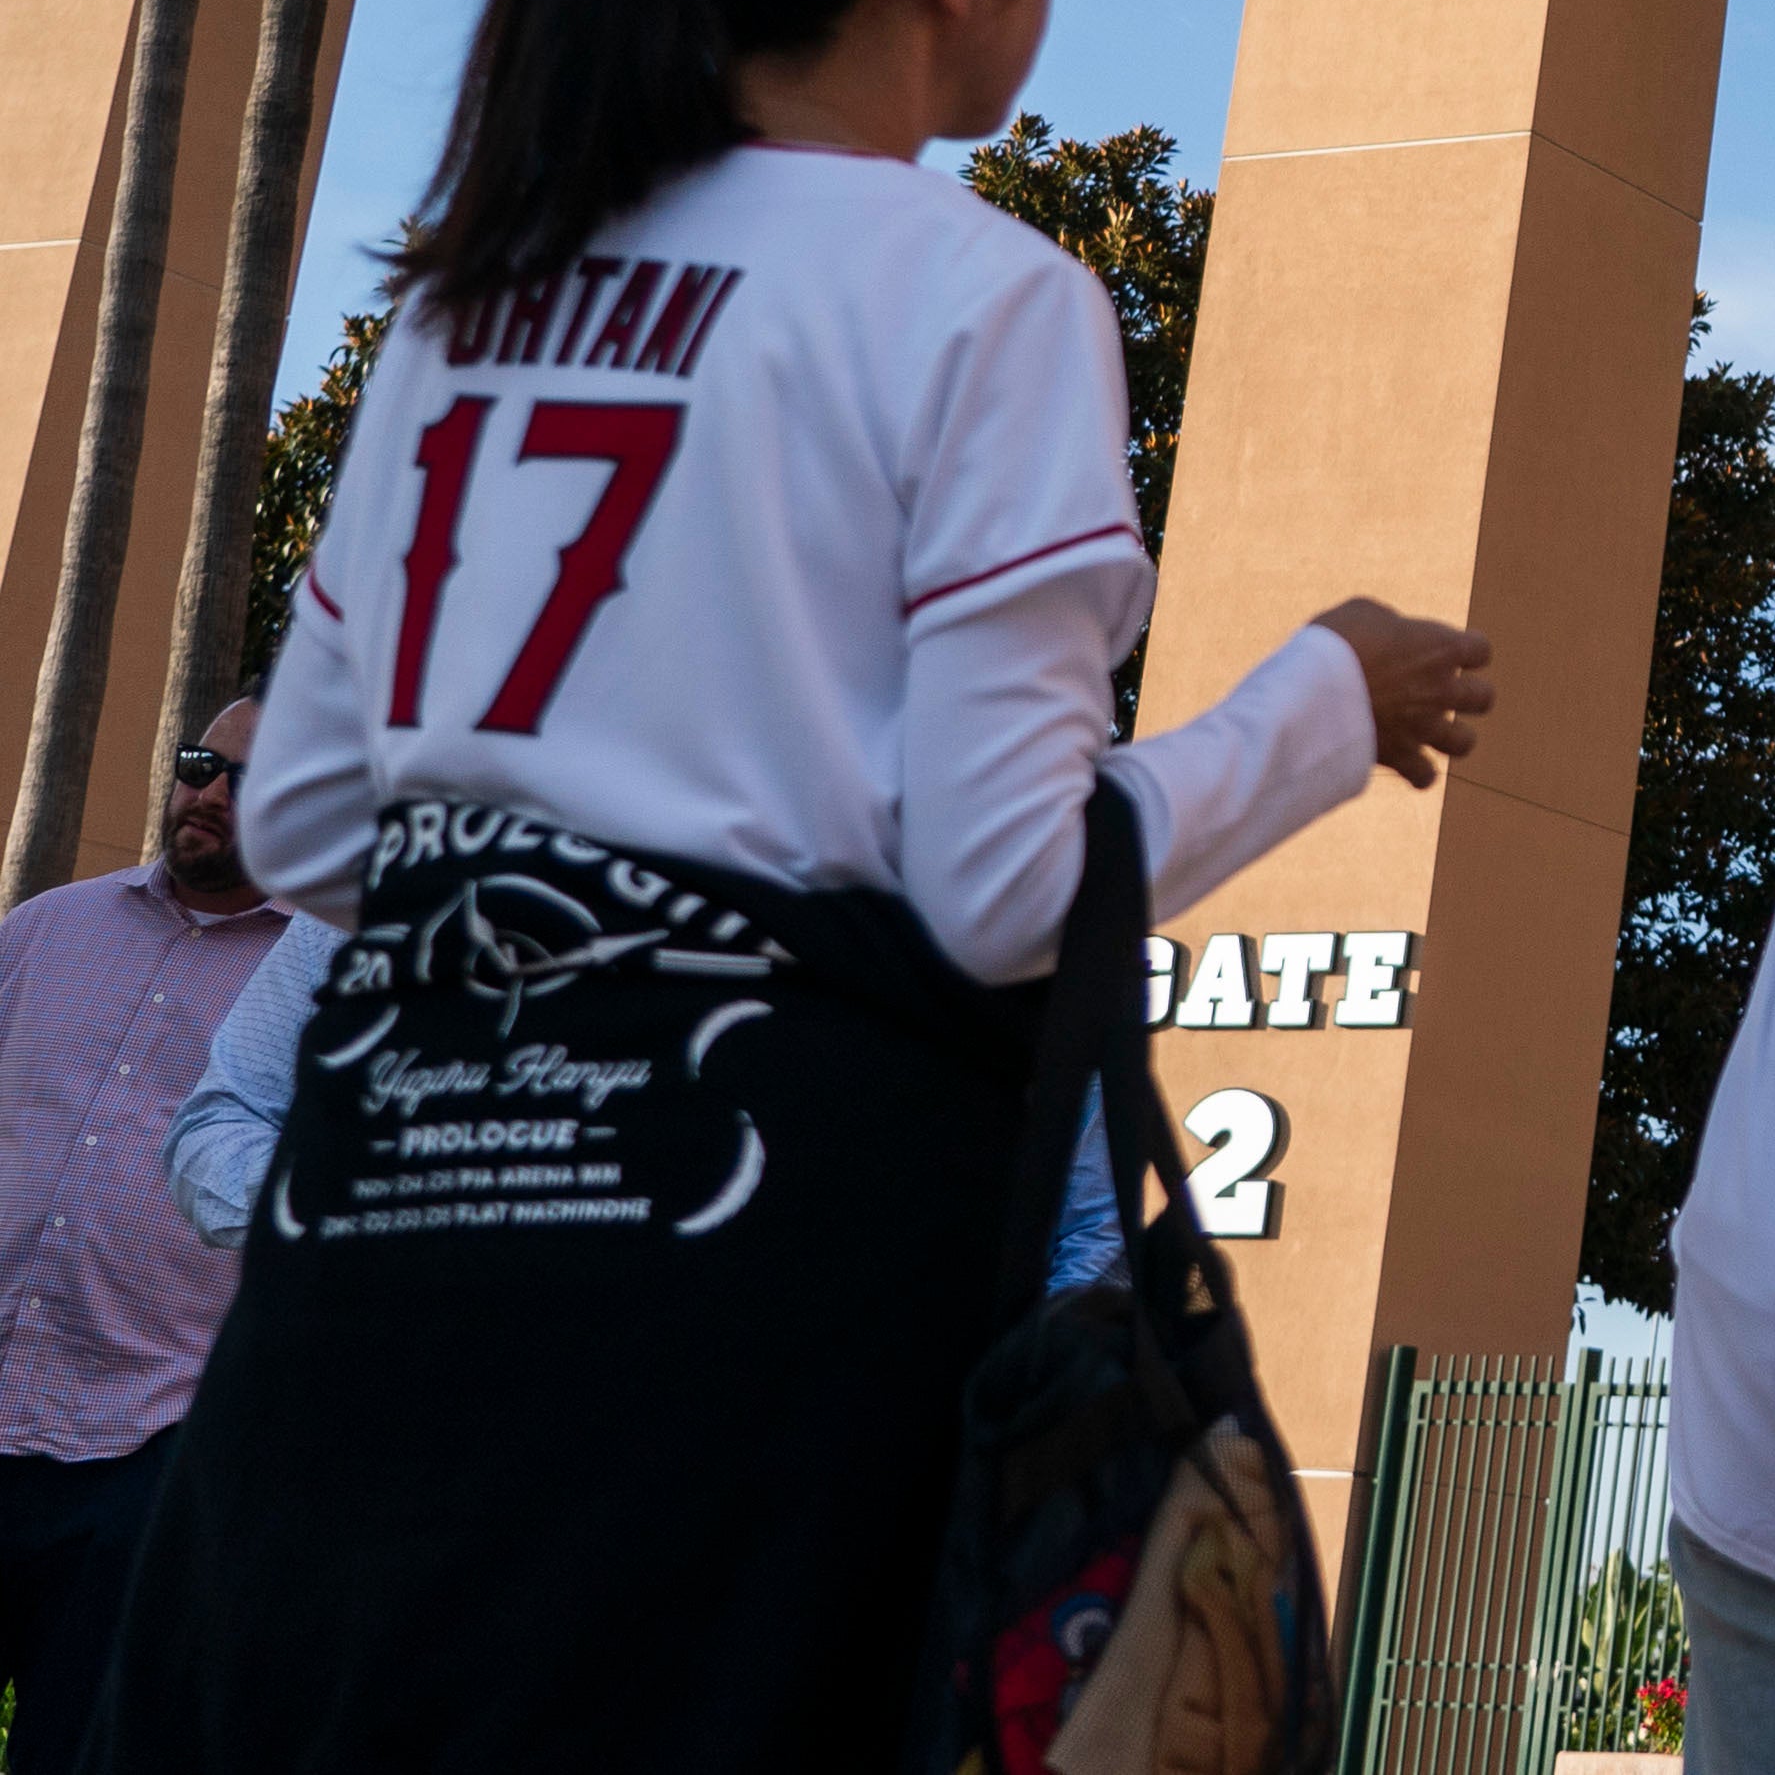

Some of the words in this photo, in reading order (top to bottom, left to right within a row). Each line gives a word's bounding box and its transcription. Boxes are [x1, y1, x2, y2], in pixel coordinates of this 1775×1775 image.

[386, 393, 689, 737] 17
[400, 1119, 580, 1158] PROLOGUE
[499, 1164, 575, 1189] ARENA
[1183, 1087, 1277, 1240] 2
[454, 1201, 510, 1224] FLAT
